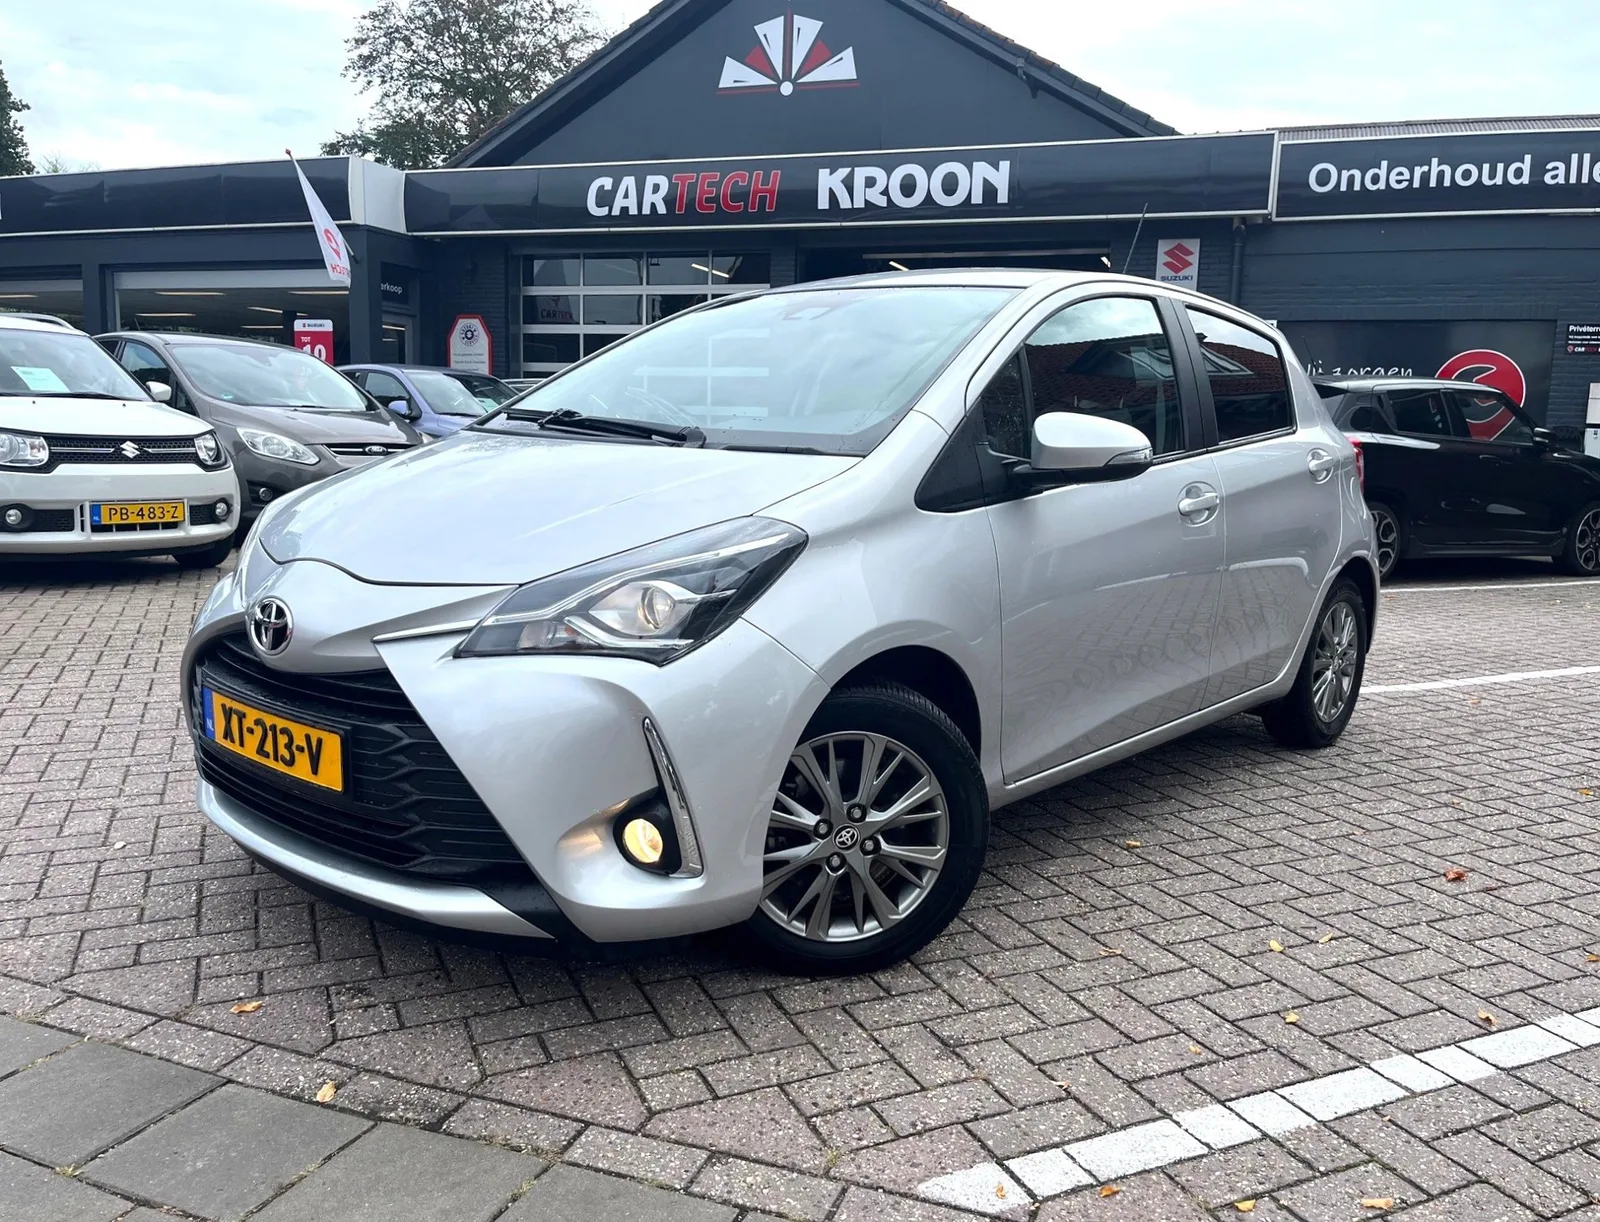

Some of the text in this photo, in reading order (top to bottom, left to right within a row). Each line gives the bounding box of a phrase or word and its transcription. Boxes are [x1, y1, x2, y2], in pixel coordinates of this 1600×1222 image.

[586, 160, 1011, 217] CARTECH KROON
[1308, 154, 1532, 193] Onderhoud
[108, 505, 179, 521] PB-483-Z
[206, 718, 215, 732] NL
[220, 703, 323, 776] XT-213-V
